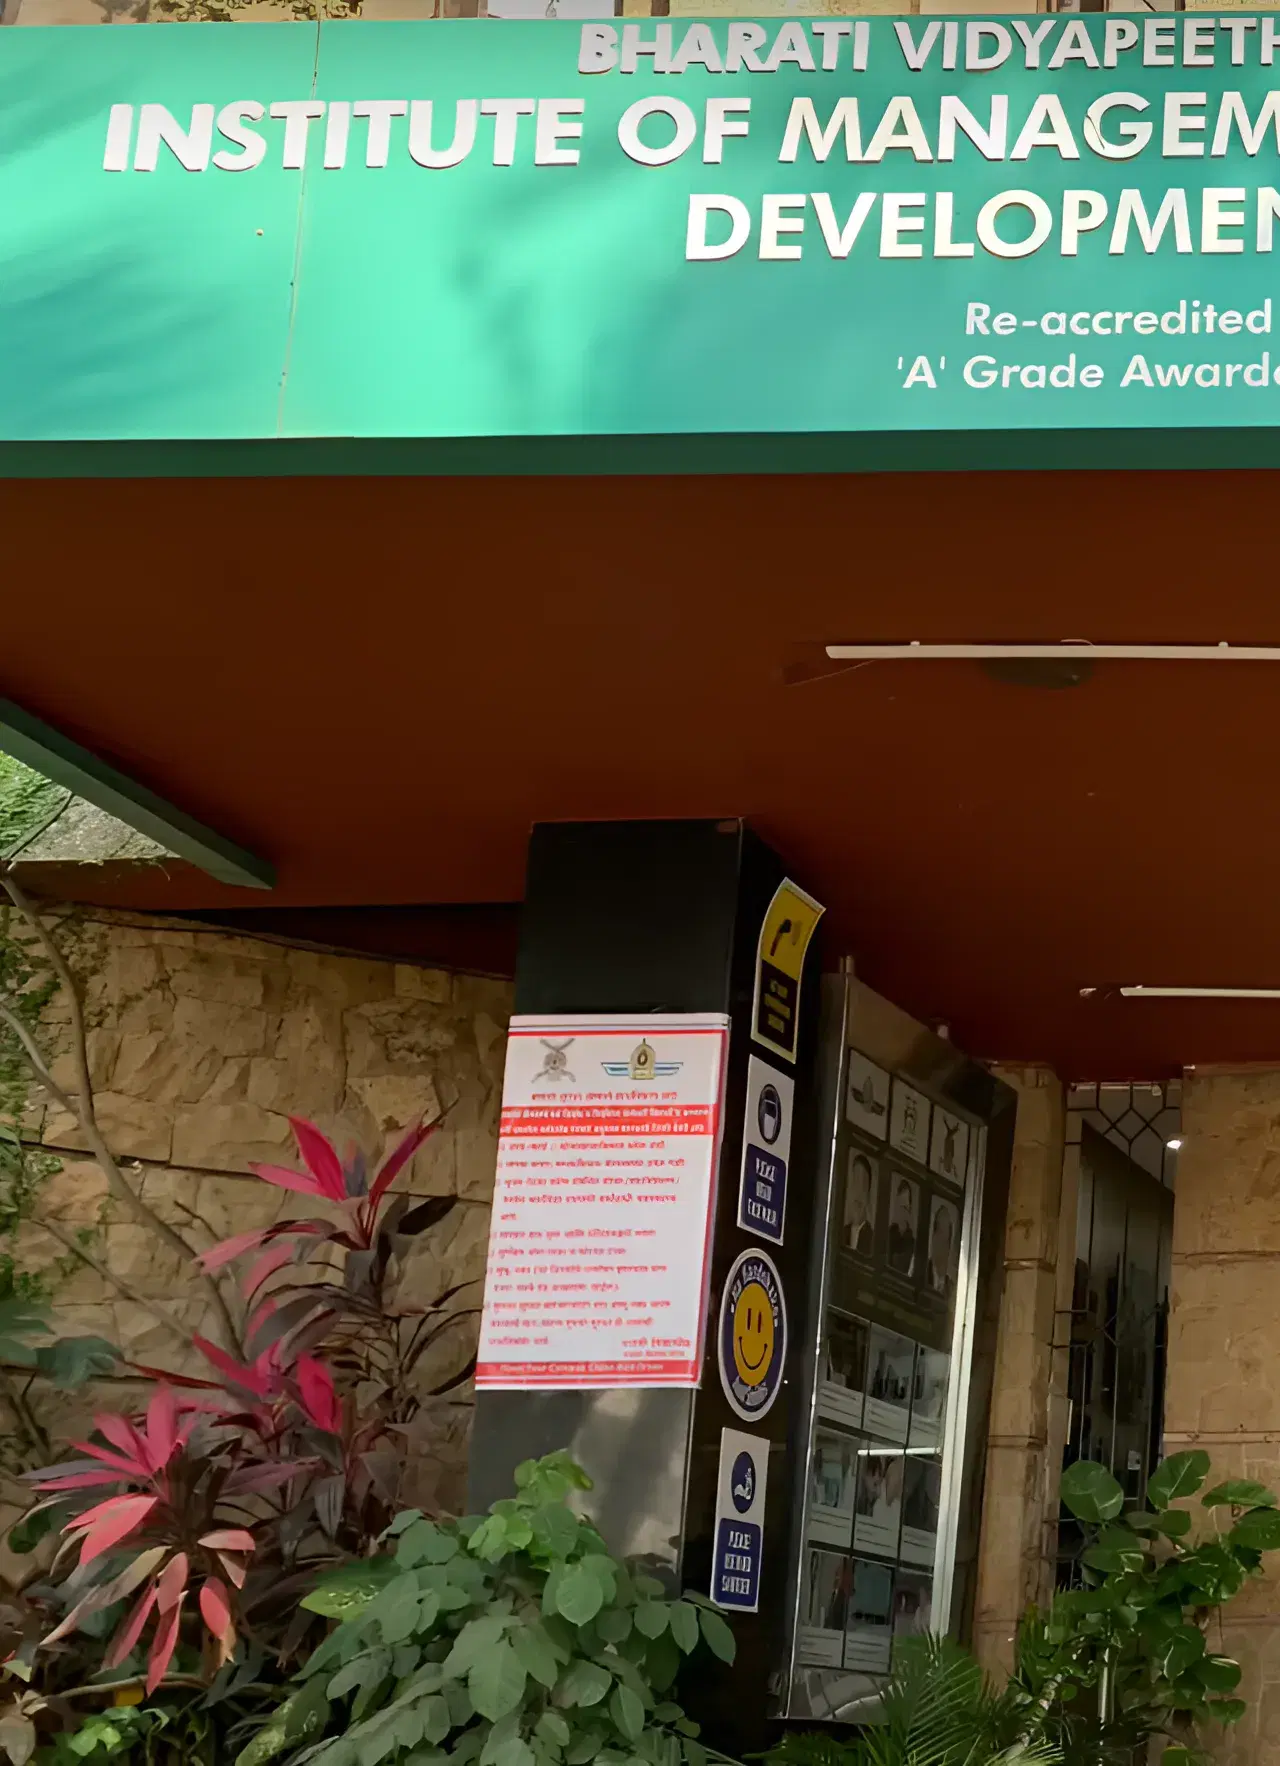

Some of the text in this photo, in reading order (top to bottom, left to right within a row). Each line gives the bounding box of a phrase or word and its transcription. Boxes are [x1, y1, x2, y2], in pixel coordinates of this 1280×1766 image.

[577, 21, 871, 76] BHARATI
[104, 98, 585, 172] INSTITUTE
[618, 96, 751, 168] OF
[966, 299, 1271, 335] Re-accredited
[964, 354, 1103, 388] Grade
